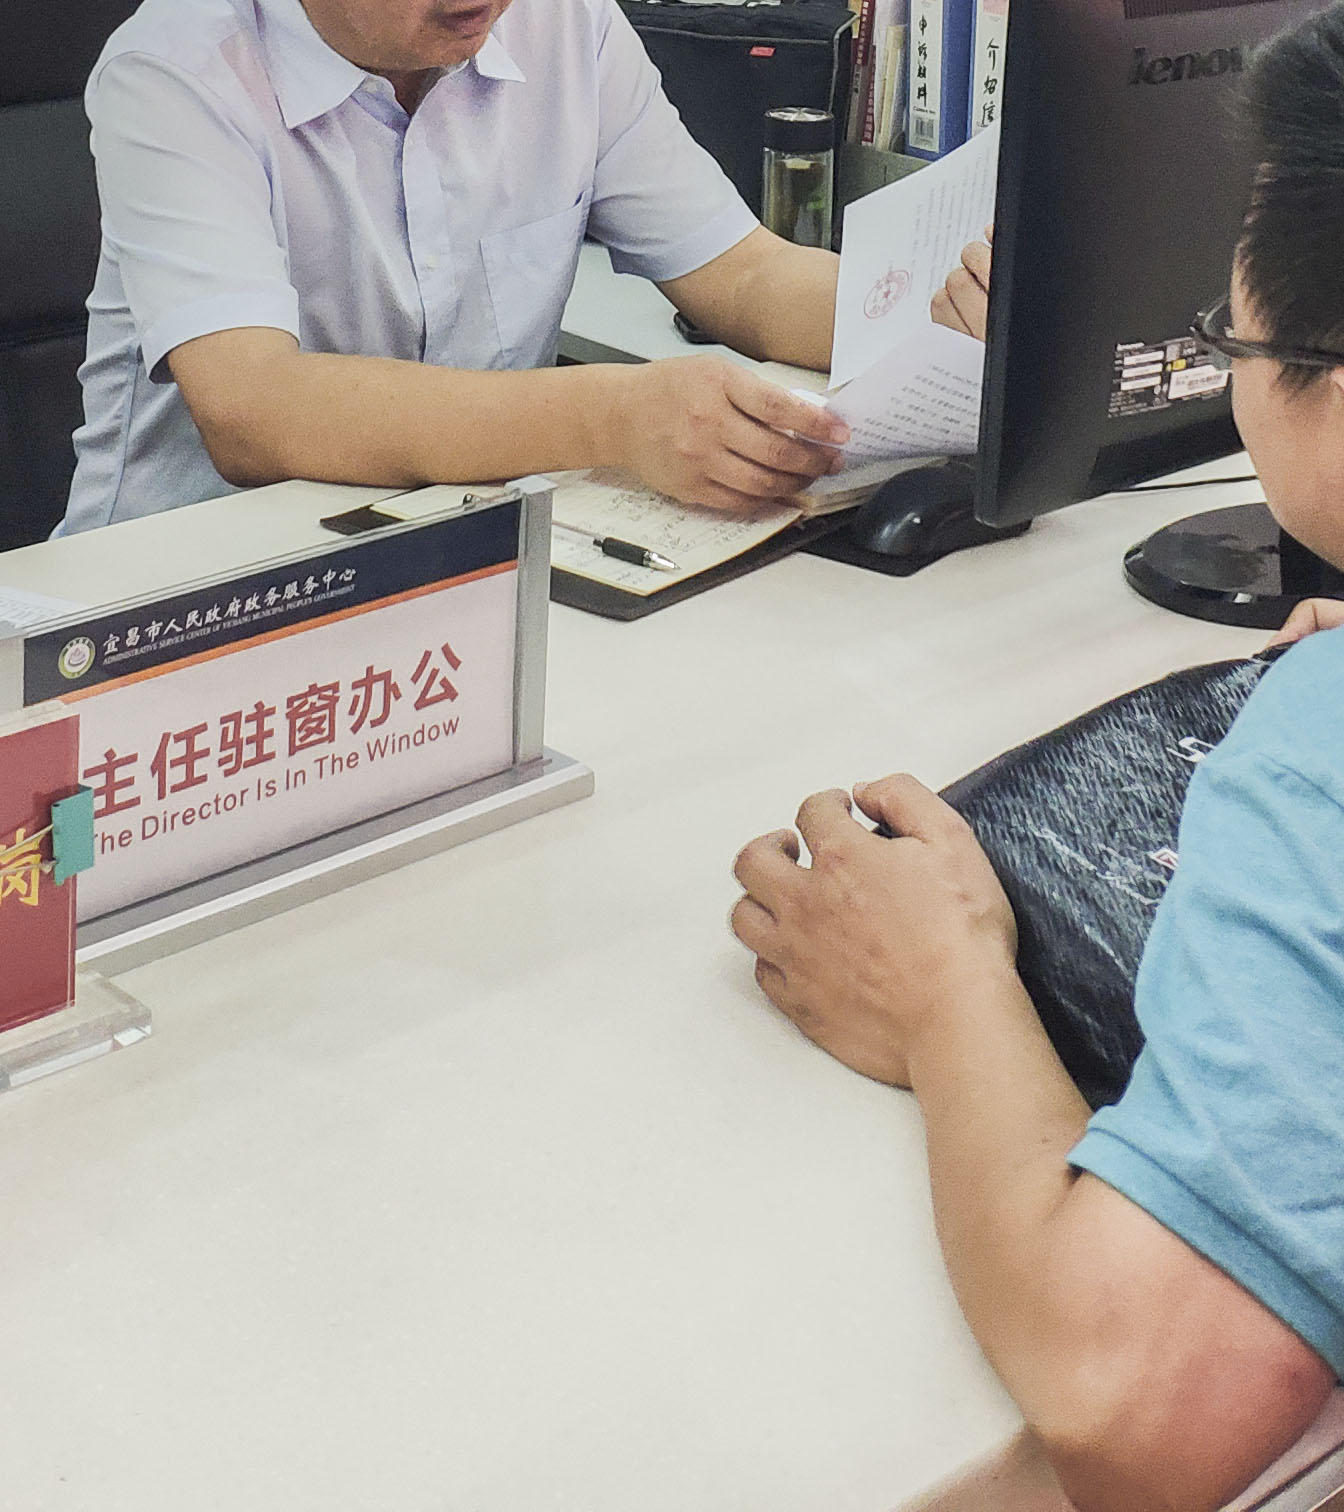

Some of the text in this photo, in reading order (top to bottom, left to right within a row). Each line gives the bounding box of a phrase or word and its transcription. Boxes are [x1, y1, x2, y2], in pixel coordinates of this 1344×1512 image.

[102, 568, 357, 656] 宜昌市人民政府政务服务中心
[83, 641, 463, 820] 主任驻窗办公
[94, 714, 460, 854] he Director Is In The Window
